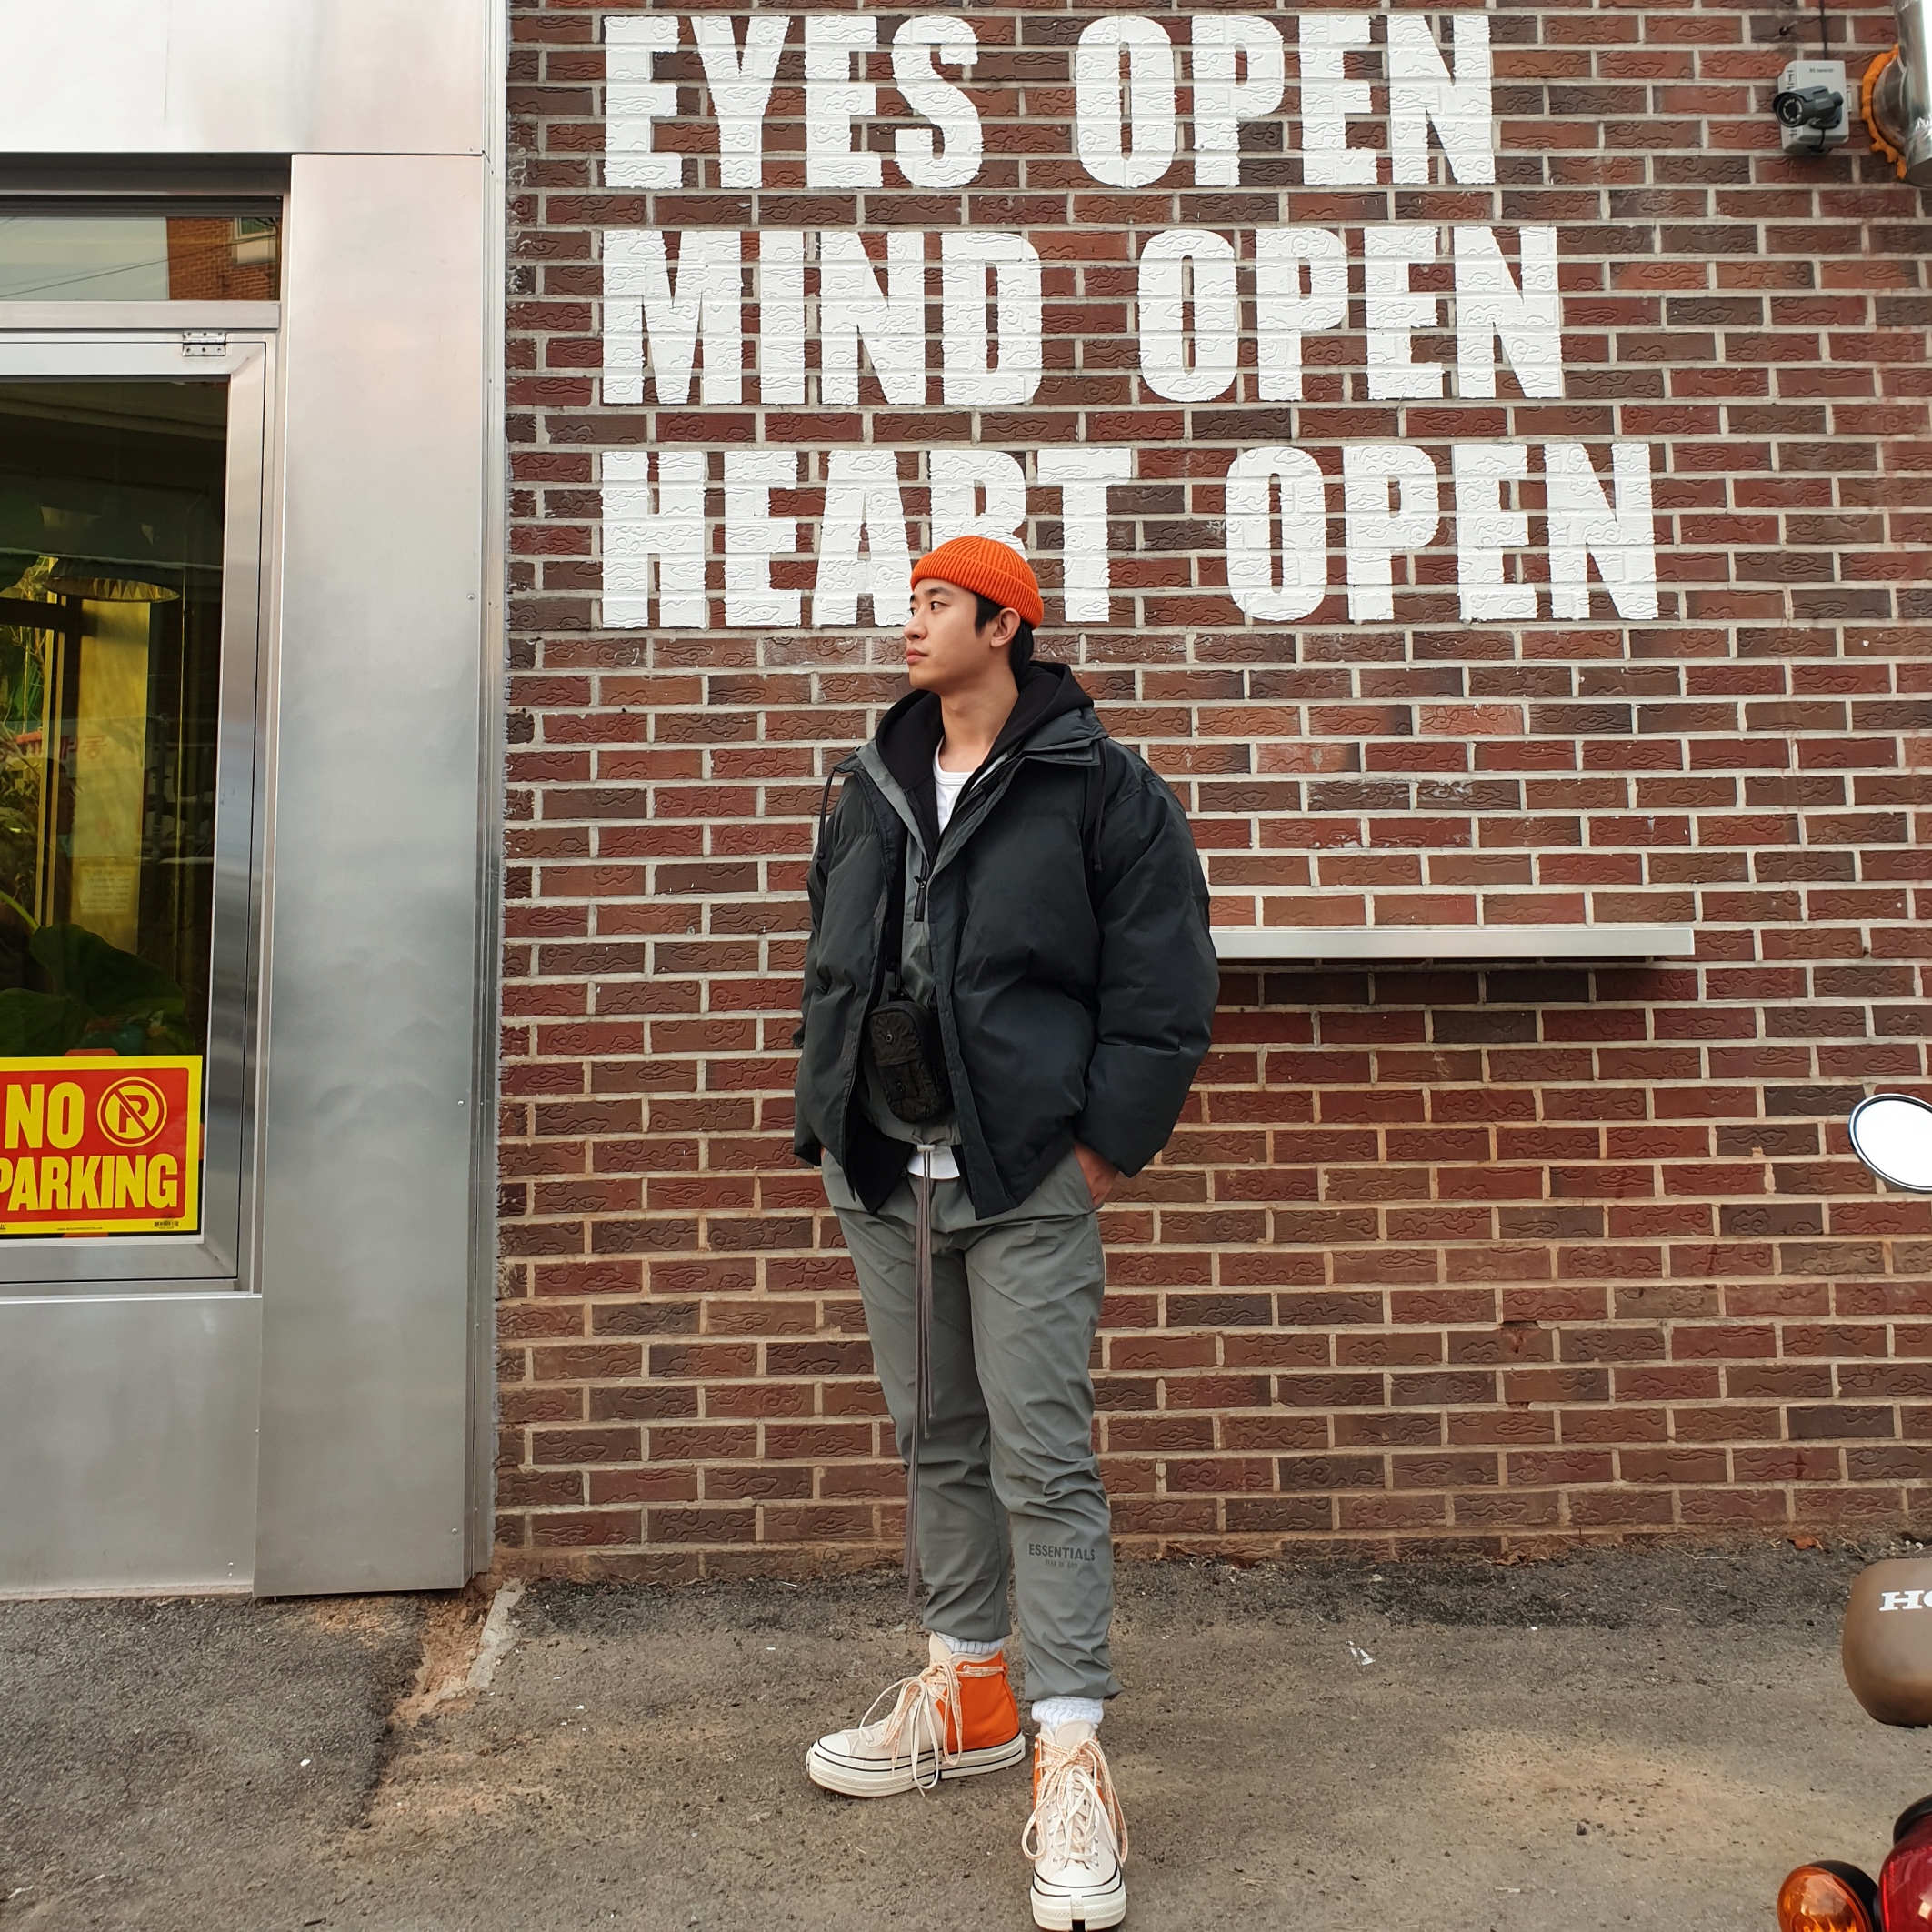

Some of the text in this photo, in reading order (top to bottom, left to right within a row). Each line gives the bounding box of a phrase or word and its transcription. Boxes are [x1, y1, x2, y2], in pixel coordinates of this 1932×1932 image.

[604, 15, 1496, 188] EYES OPEN
[602, 226, 1563, 406] MIND OPEN
[601, 443, 1659, 628] HEART OPEN
[5, 1081, 85, 1149] NO
[1028, 1544, 1096, 1561] ESSENTIALS
